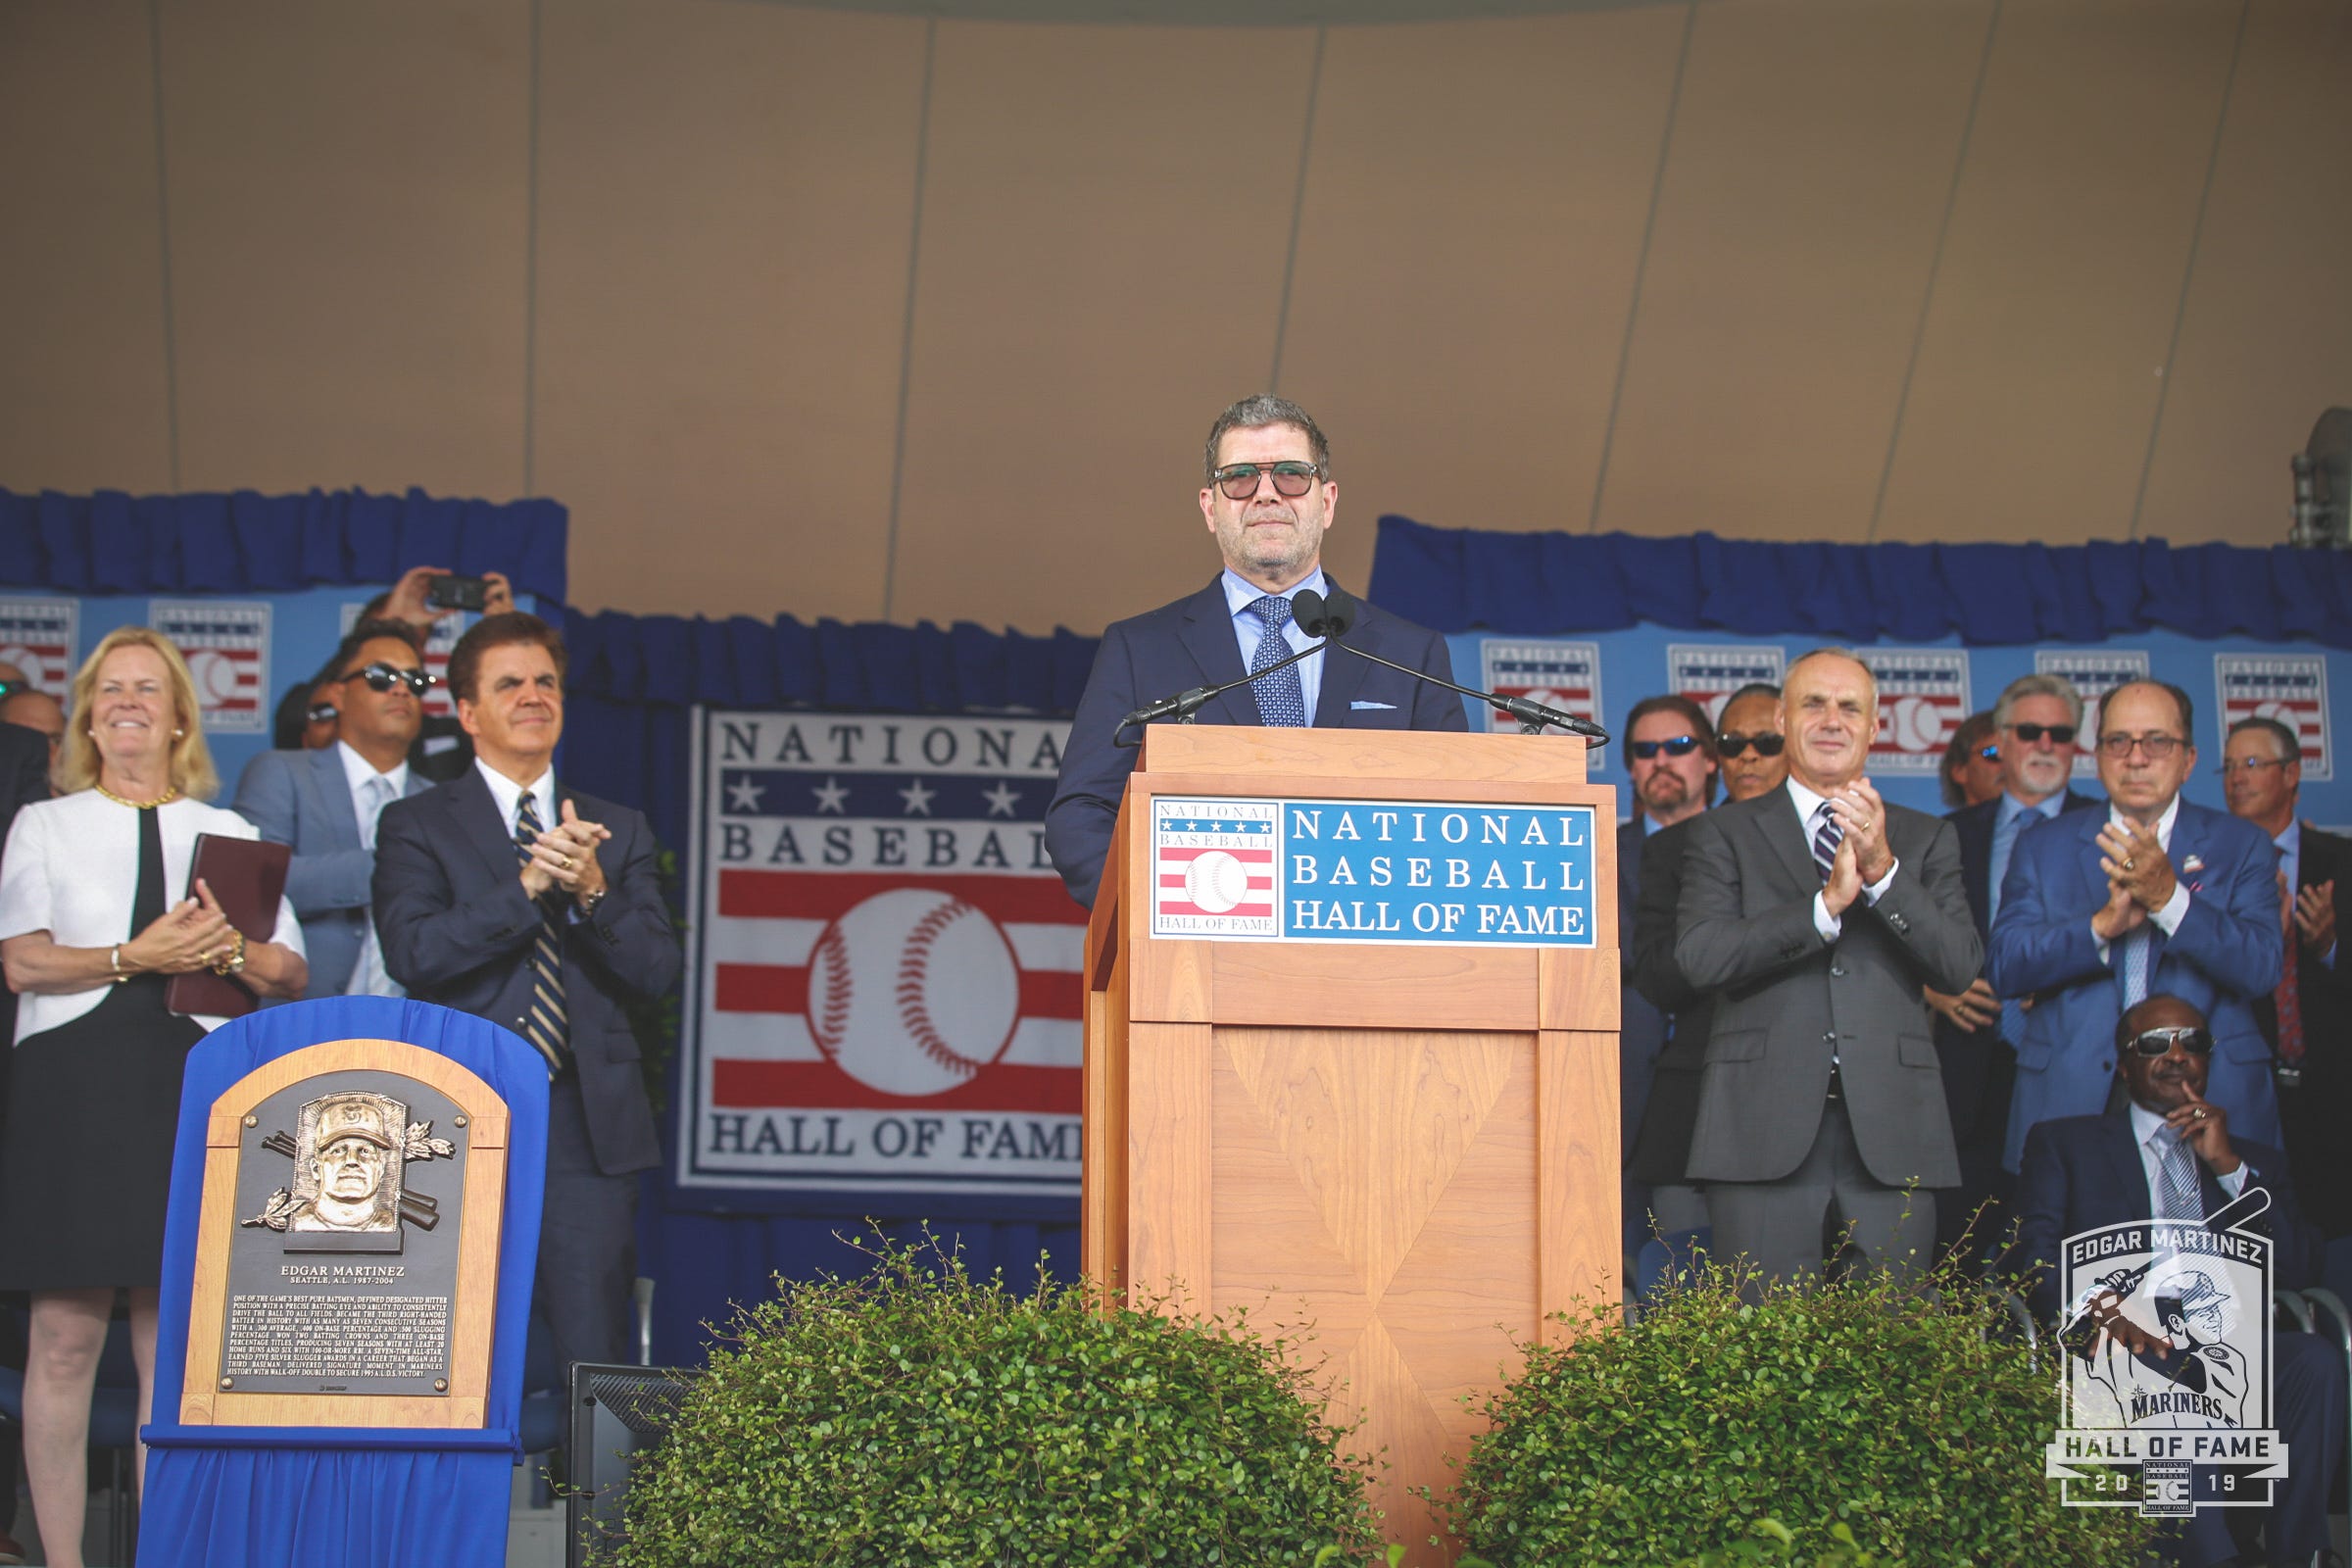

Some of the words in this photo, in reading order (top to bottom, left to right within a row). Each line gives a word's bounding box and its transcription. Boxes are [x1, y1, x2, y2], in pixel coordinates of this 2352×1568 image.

[720, 721, 1061, 770] NATIONA
[1160, 805, 1273, 818] NATIONAL
[1292, 810, 1584, 846] NATIONAL
[719, 823, 1054, 868] BASEBAL
[1160, 834, 1272, 847] BASEBALL
[1292, 856, 1584, 891] BASEBALL
[1160, 917, 1200, 929] HALL
[1205, 918, 1226, 929] OF
[1232, 919, 1272, 930] FAME
[1292, 901, 1400, 930] HALL
[1411, 903, 1465, 932] OF
[1477, 905, 1585, 936] FAME
[709, 1113, 856, 1156] HALL
[871, 1118, 944, 1158] OF
[960, 1119, 1083, 1161] FAM
[281, 1266, 328, 1275] EDGAR
[333, 1266, 405, 1277] MARTINEZ
